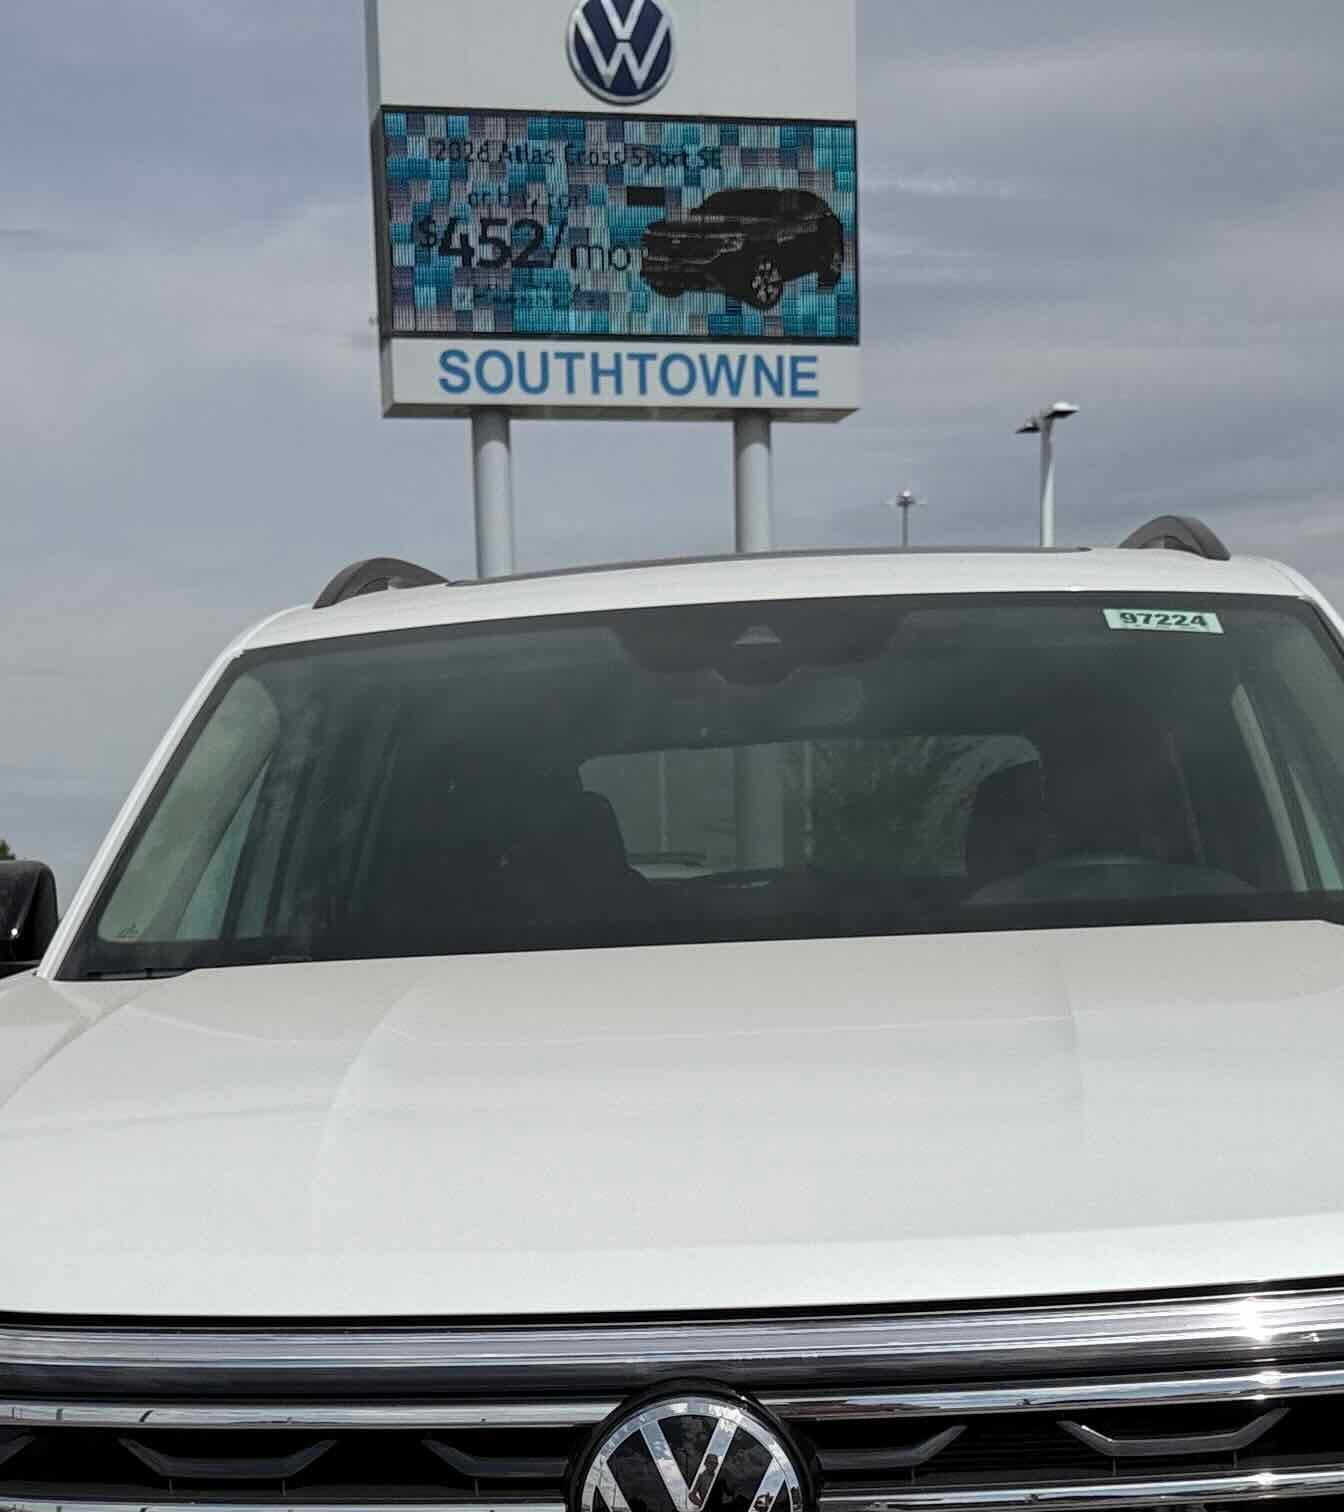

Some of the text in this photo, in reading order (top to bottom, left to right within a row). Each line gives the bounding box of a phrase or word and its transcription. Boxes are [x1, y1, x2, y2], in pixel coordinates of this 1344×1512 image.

[571, 0, 670, 89] VW
[498, 140, 556, 165] Atlas
[564, 142, 625, 167] Cross
[632, 144, 690, 175] Sport
[438, 349, 819, 399] SOUTHTOWNE
[1119, 611, 1208, 627] 97224
